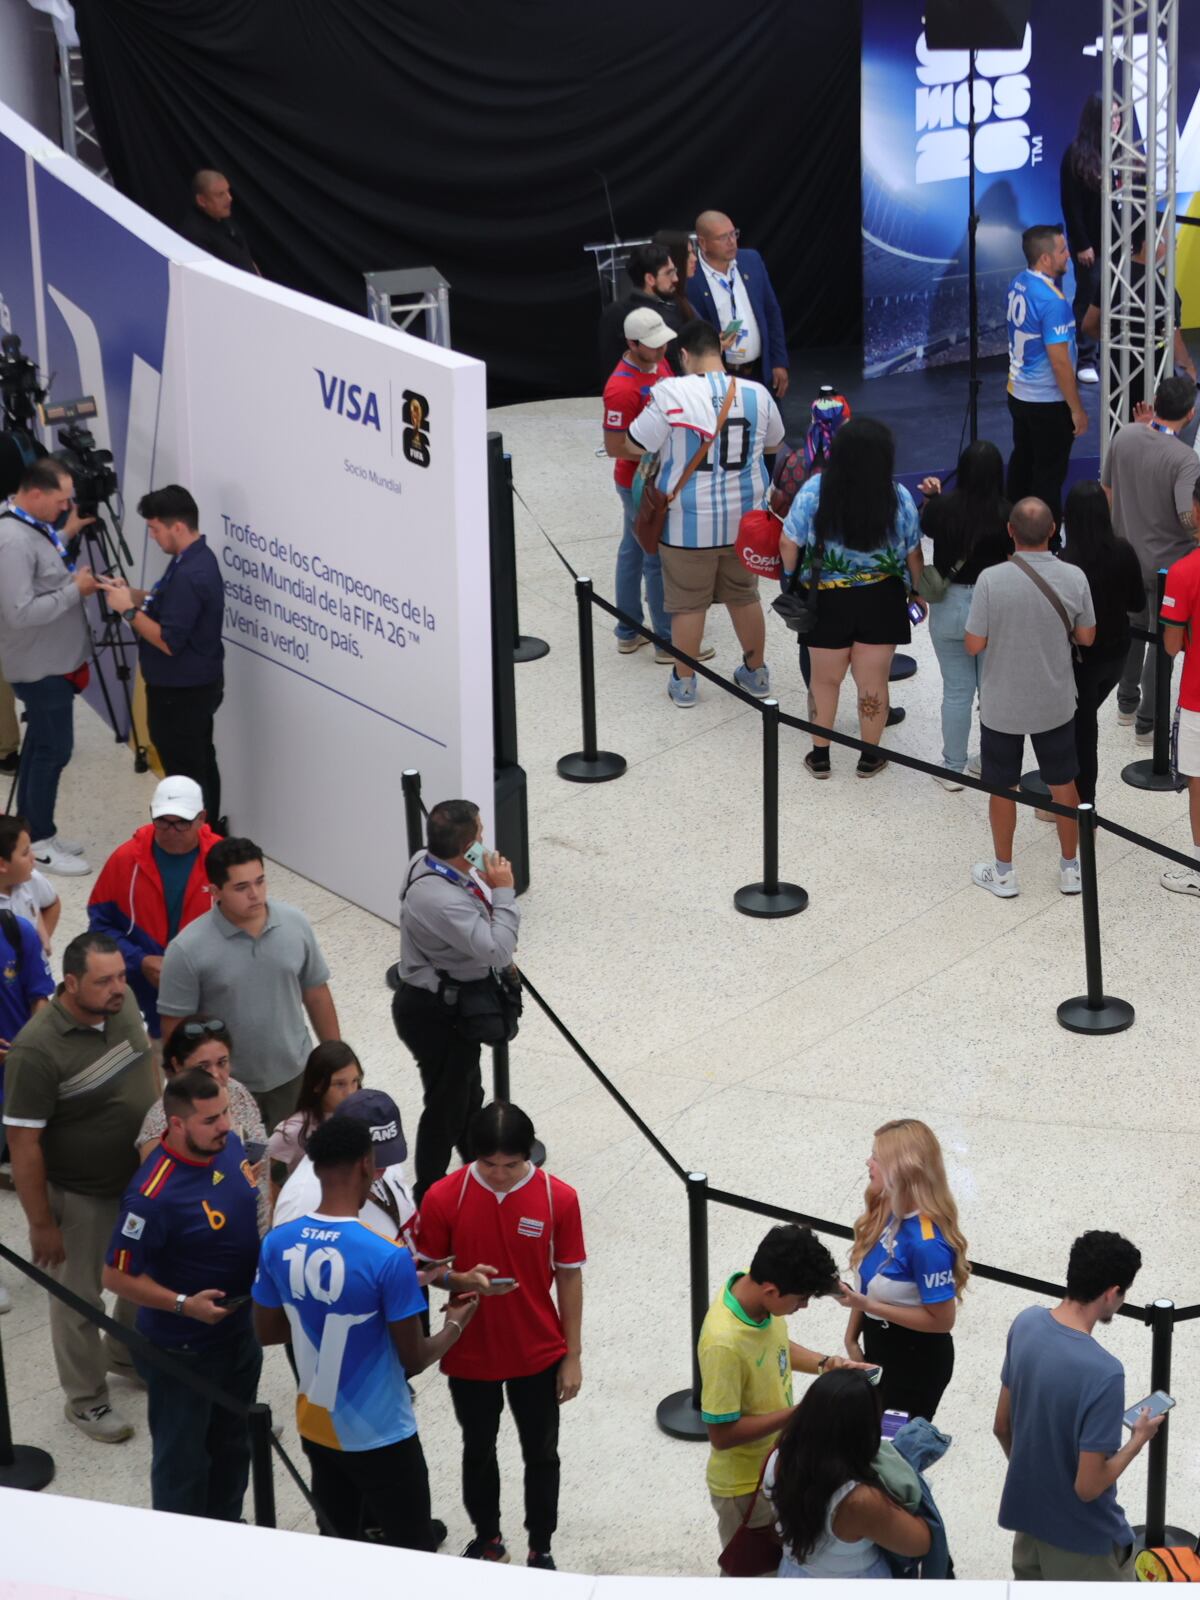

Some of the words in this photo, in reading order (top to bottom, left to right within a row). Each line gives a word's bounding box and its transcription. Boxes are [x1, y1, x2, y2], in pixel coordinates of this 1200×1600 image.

[312, 366, 381, 432] VISA
[344, 458, 368, 480] Socio
[369, 469, 402, 495] Mundial
[221, 513, 267, 552] Trofeo
[269, 538, 288, 562] de
[289, 544, 310, 572] los
[312, 556, 399, 615] Campeones
[401, 598, 421, 624] de
[423, 605, 435, 631] la
[222, 546, 259, 578] Copa
[261, 562, 317, 606] Mundial
[319, 590, 337, 616] de
[339, 597, 351, 623] la
[354, 605, 385, 639] FIFA
[255, 593, 272, 616] en
[274, 603, 328, 641] nuestro
[260, 626, 269, 643] a
[271, 630, 310, 663] verlo!
[369, 1120, 399, 1143] ANS
[202, 1200, 226, 1230] 6
[300, 1227, 341, 1243] STAFF
[282, 1243, 345, 1305] 10
[923, 1269, 956, 1289] VISA
